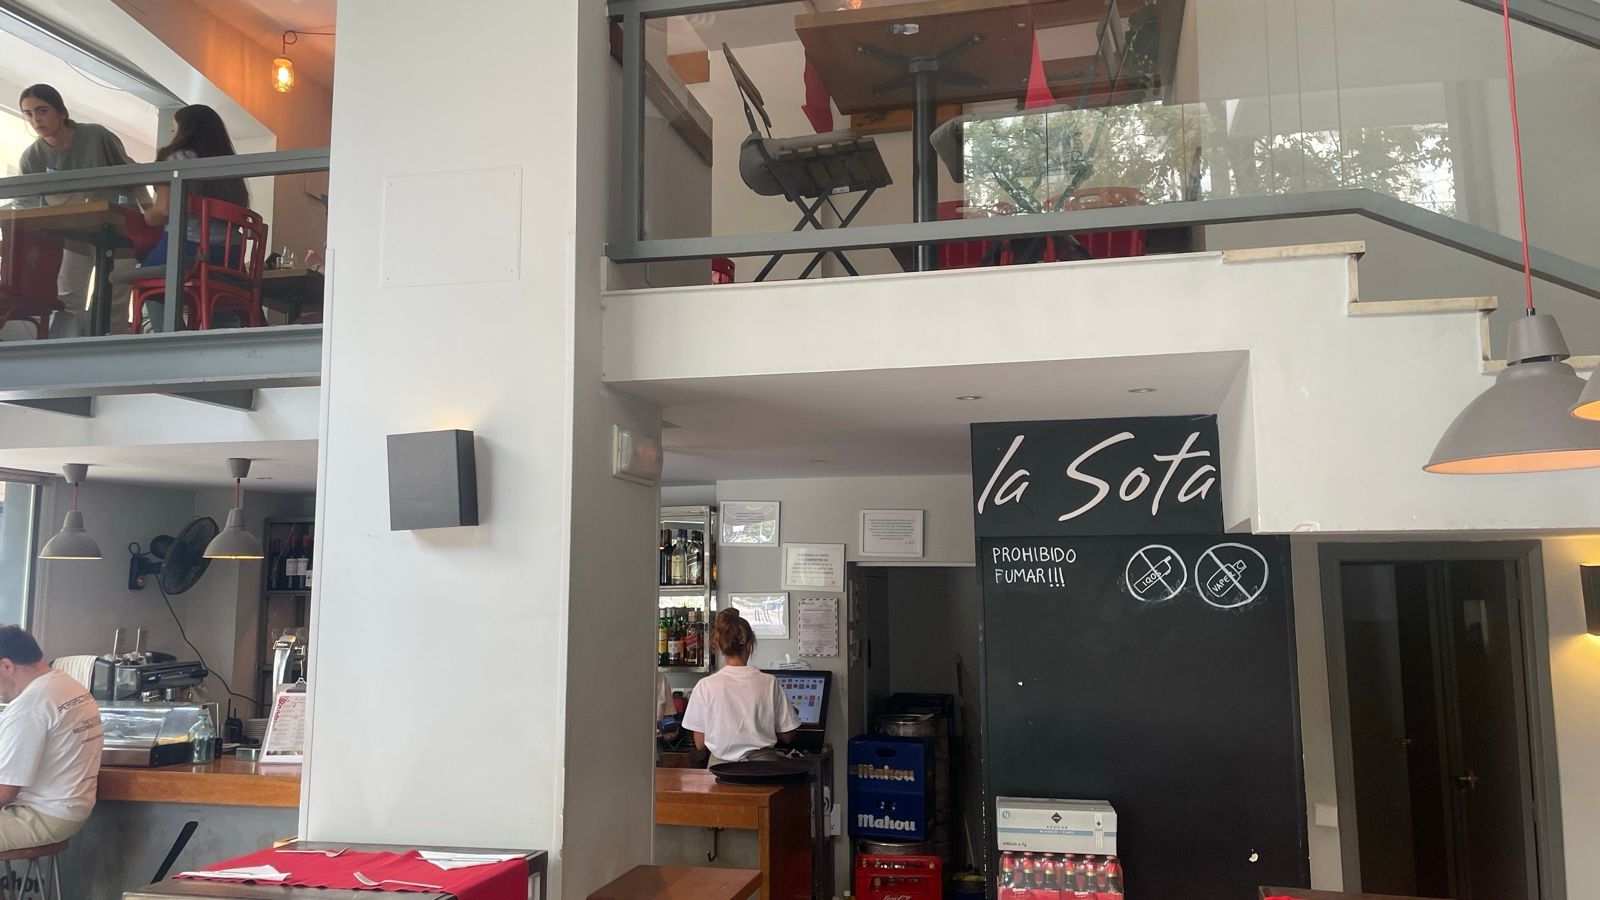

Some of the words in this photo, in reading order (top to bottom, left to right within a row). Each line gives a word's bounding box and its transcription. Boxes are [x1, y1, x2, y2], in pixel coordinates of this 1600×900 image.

[978, 435, 1030, 514] la
[1058, 431, 1216, 521] Sota
[992, 546, 1077, 564] PROHIBIDO
[995, 567, 1066, 587] FUMAR!!!
[858, 763, 915, 782] Mahou
[857, 813, 916, 831] Mahou
